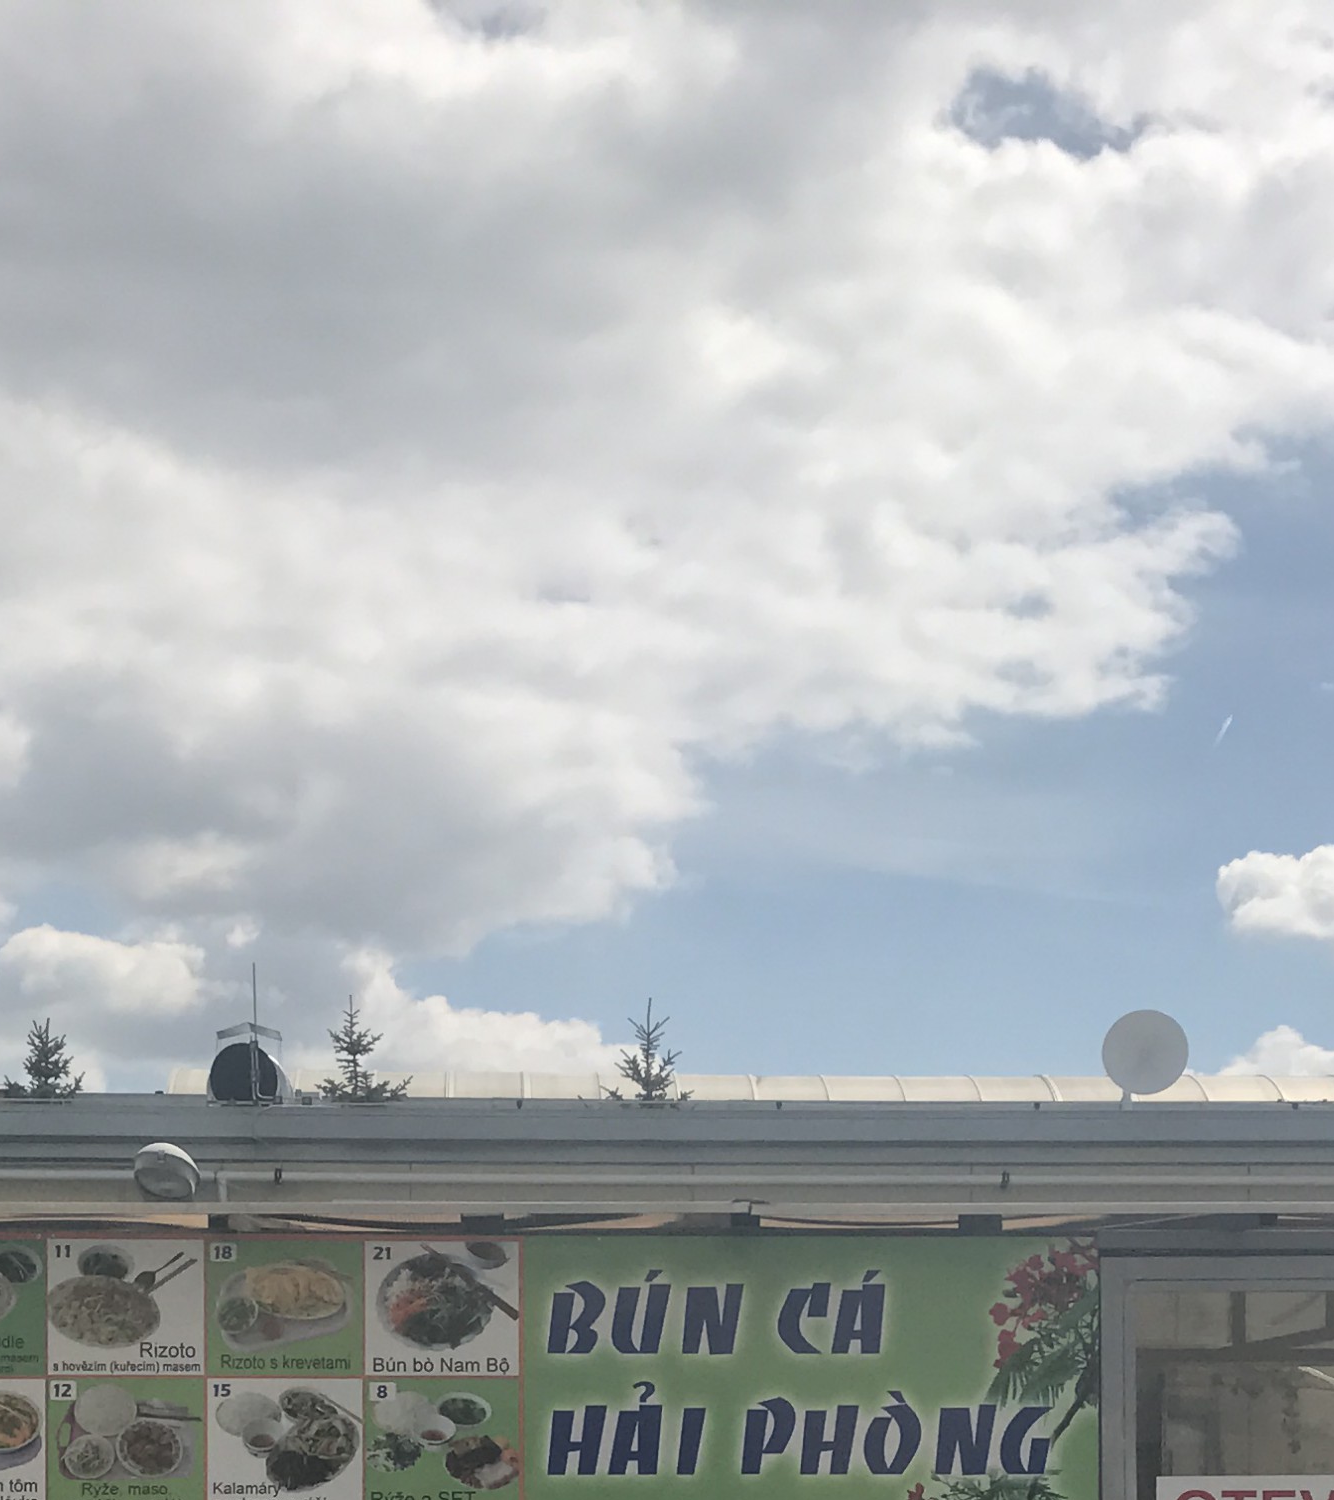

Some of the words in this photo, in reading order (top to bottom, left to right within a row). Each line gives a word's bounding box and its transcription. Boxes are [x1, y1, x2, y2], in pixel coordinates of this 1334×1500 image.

[55, 1245, 71, 1258] 11
[213, 1246, 232, 1259] 18
[373, 1247, 392, 1260] 21
[547, 1269, 744, 1355] BÚN
[777, 1269, 886, 1355] CÁ
[140, 1342, 196, 1359] Rizoto
[53, 1363, 59, 1371] s
[163, 1362, 201, 1371] masem
[220, 1354, 266, 1369] Rizoto
[269, 1357, 278, 1369] s
[282, 1354, 351, 1370] krevetami
[372, 1357, 407, 1373] Bún
[413, 1357, 435, 1373] bò
[440, 1358, 480, 1373] Nam
[486, 1356, 510, 1375] Bộ
[53, 1384, 72, 1398] 12
[213, 1384, 230, 1397] 15
[377, 1386, 387, 1398] 8
[547, 1381, 706, 1475] HẢI
[740, 1391, 1054, 1475] PHÒNG
[9, 1478, 38, 1492] tôm
[213, 1481, 281, 1498] Kalamáry
